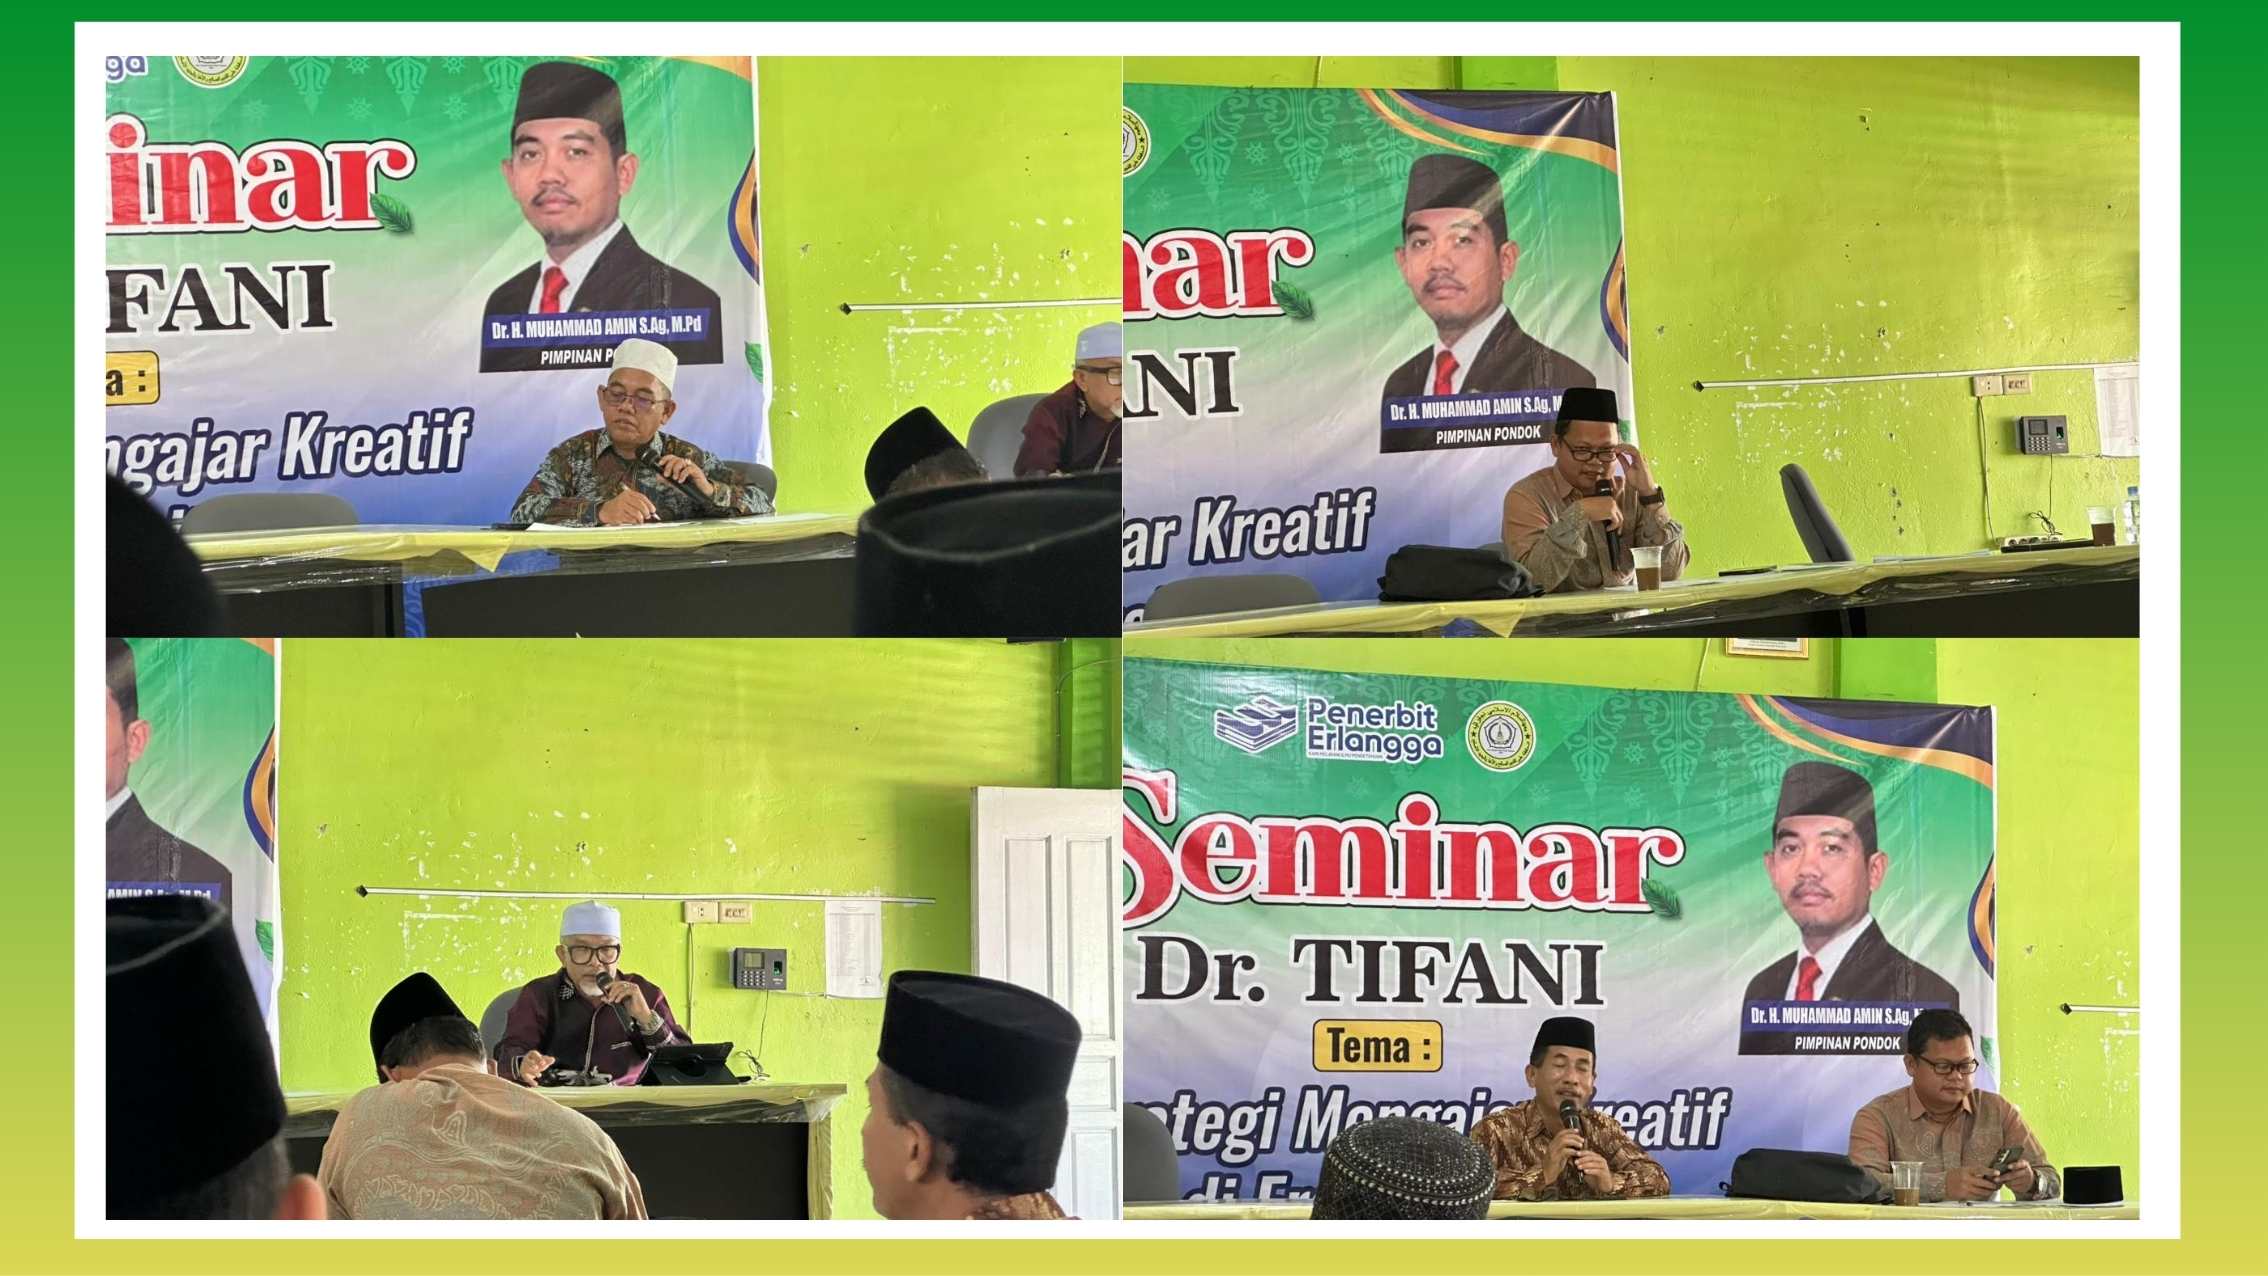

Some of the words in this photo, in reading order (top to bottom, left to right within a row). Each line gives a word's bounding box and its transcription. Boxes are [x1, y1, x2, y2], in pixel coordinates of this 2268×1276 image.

[106, 120, 409, 227] inar
[106, 264, 334, 333] FANI
[491, 321, 510, 340] Dr.
[511, 321, 524, 339] H.
[526, 318, 601, 338] MUHAMMAD
[605, 316, 637, 336] AMIN
[671, 314, 702, 333] M.Pd
[540, 348, 601, 366] PIMPINAN
[1123, 351, 1239, 418] NI
[1390, 404, 1407, 421] Dr.
[1408, 403, 1420, 420] H.
[1422, 400, 1490, 419] MUHAMMAD
[1493, 397, 1523, 415] AMIN
[282, 411, 469, 476] Kreatif
[1436, 427, 1492, 445] PIMPINAN
[1494, 424, 1541, 441] PONDOK
[1193, 490, 1373, 562] Kreatif
[1308, 697, 1436, 729] Penerbit
[1308, 725, 1442, 762] Erlangga
[1123, 774, 1678, 921] Seminar
[1136, 936, 1265, 1002] Dr.
[1293, 938, 1605, 1006] TIFANI
[1751, 1007, 1768, 1024] Dr.
[1769, 1007, 1780, 1024] H.
[1782, 1007, 1851, 1024] MUHAMMAD
[1853, 1007, 1883, 1024] AMIN
[1327, 1027, 1411, 1063] Tema
[1795, 1036, 1851, 1050] PIMPINAN
[1853, 1036, 1901, 1050] PONDOK
